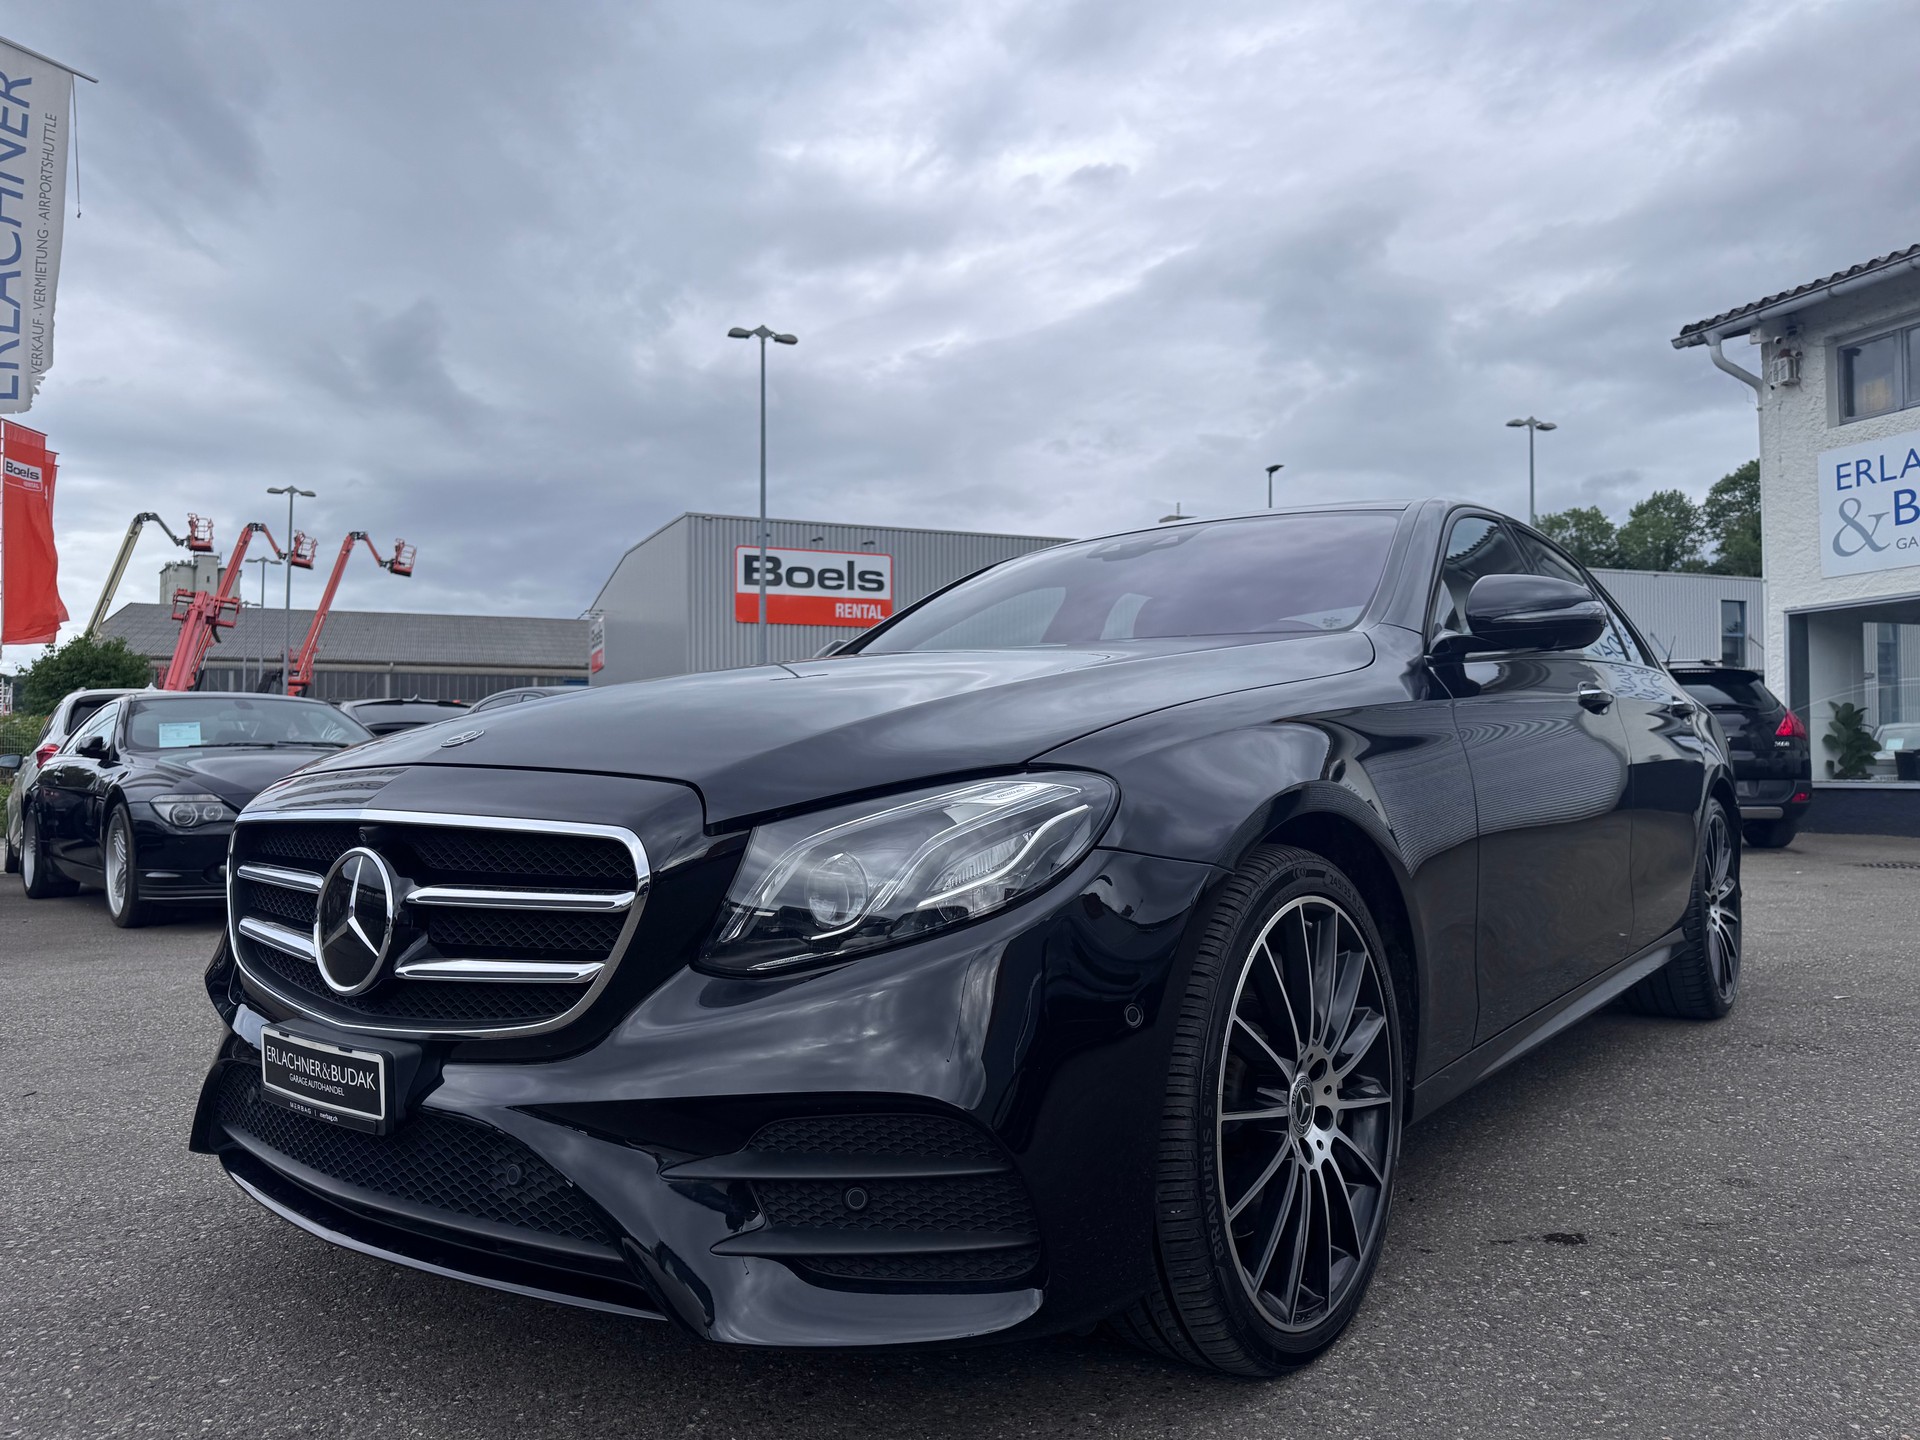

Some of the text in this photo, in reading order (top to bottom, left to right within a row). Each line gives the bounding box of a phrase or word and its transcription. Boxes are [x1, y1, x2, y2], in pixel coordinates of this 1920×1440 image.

[31, 112, 57, 375] VERKAUF VERMIETUNG AIRPORTSHUTTLE
[6, 460, 40, 480] Boels
[1832, 497, 1890, 557] &
[744, 554, 885, 592] Boels
[835, 602, 885, 620] RENTAL
[266, 1045, 376, 1091] ERLACHNER&BUDAK
[289, 1073, 345, 1097] GARAGE AUTOHANDEL
[1203, 1127, 1224, 1260] BRAVURIS
